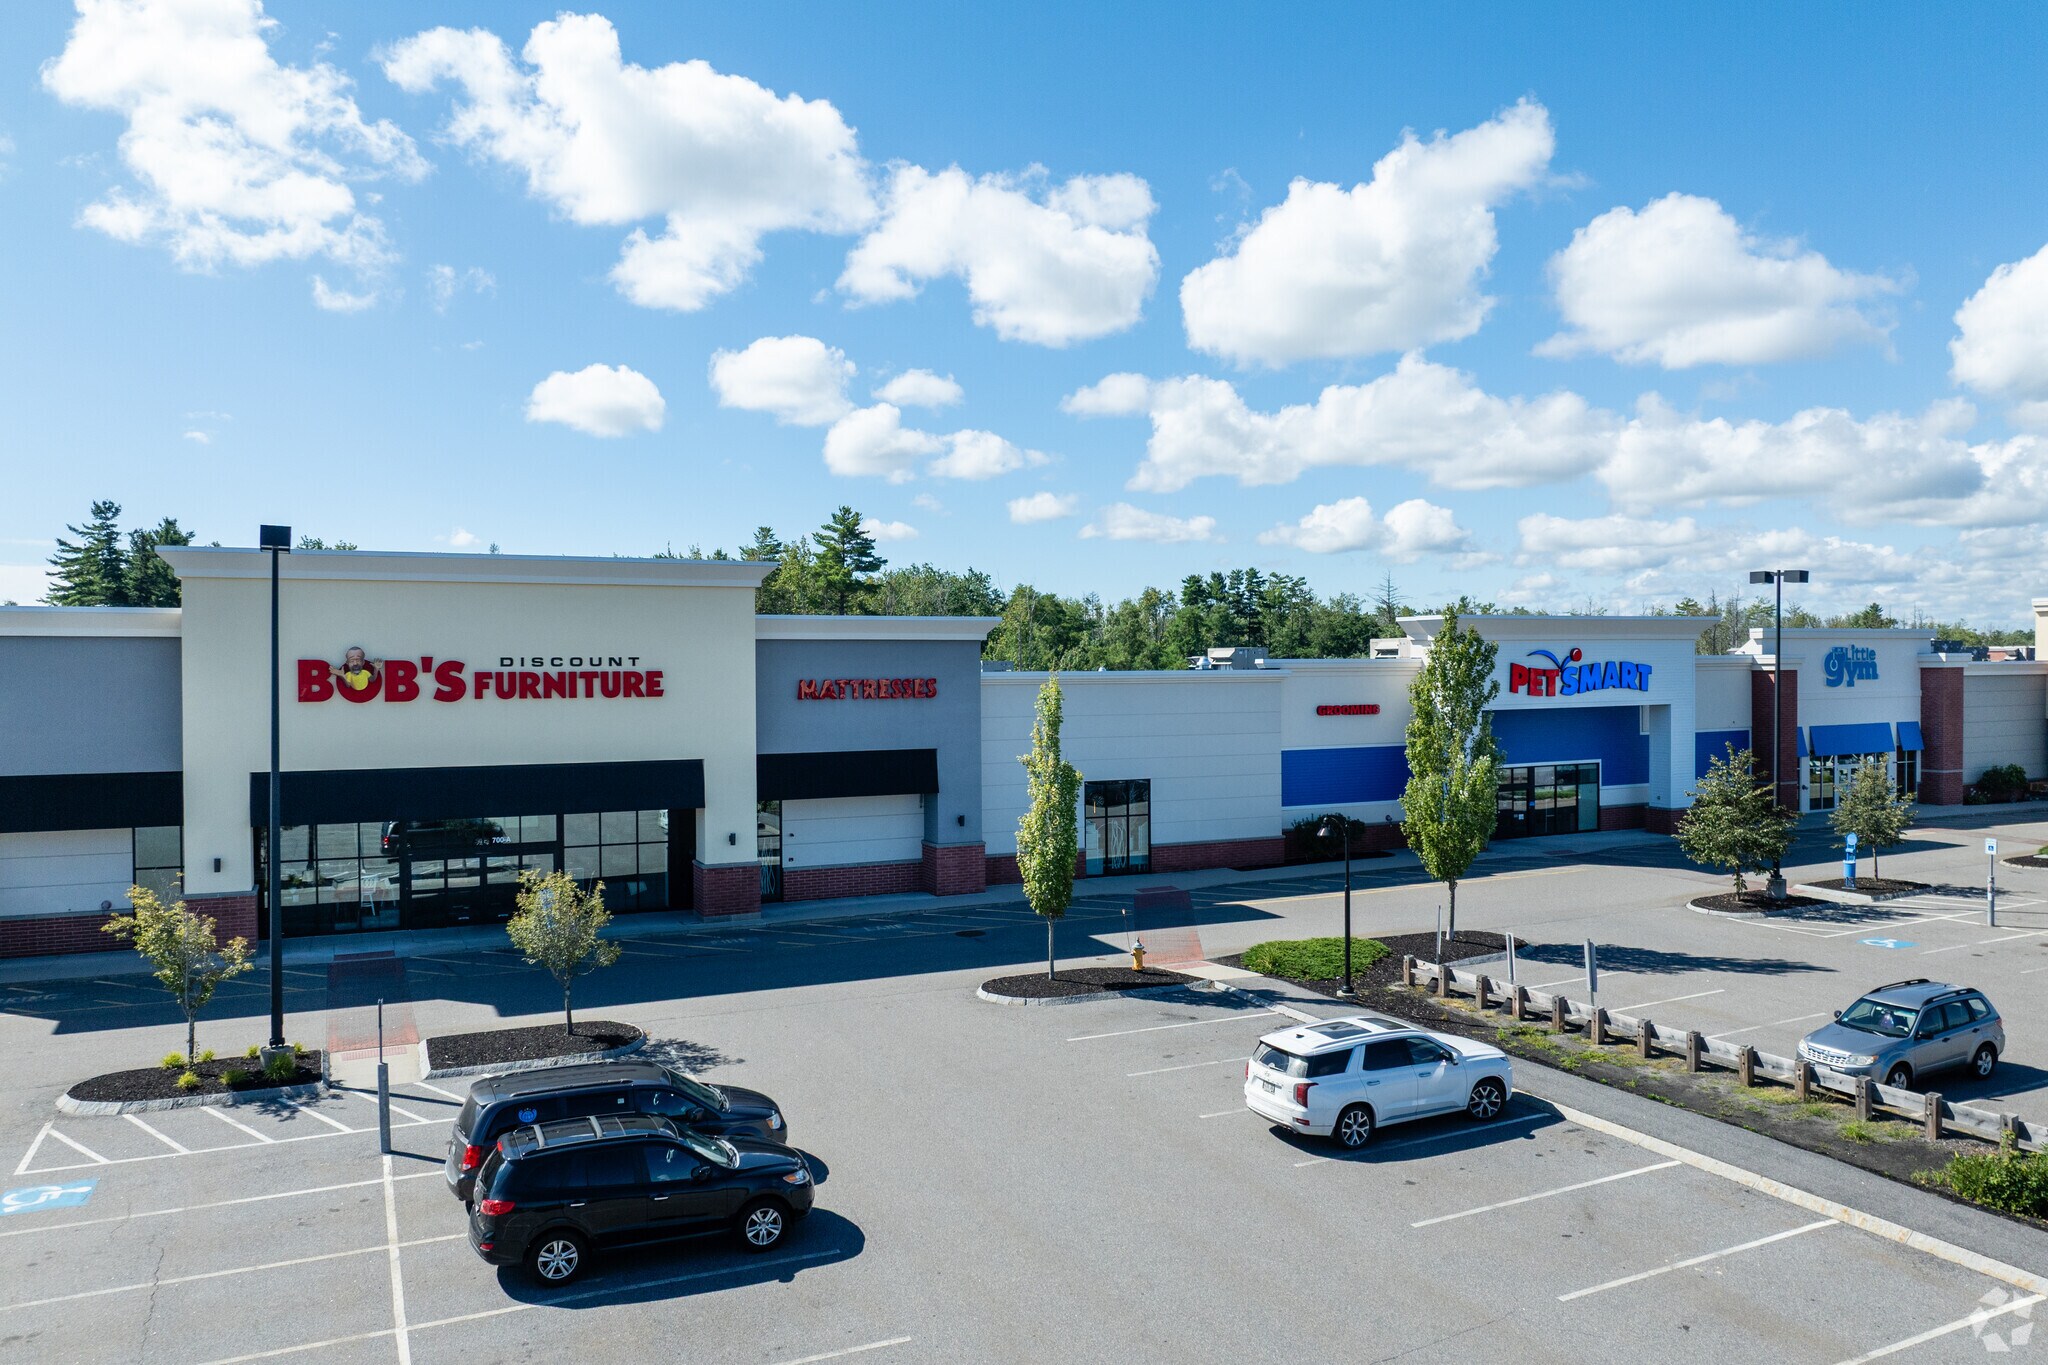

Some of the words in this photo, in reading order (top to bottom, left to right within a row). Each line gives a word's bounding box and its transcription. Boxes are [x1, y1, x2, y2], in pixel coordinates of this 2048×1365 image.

[500, 657, 640, 667] DISCOUNT
[1845, 644, 1876, 661] Little
[298, 657, 467, 703] BOB'S
[1510, 661, 1652, 697] PETSMART
[1824, 650, 1878, 687] gym
[474, 671, 664, 700] FURNITURE
[798, 678, 938, 700] MATTRESSES
[1316, 704, 1380, 716] GROOMING
